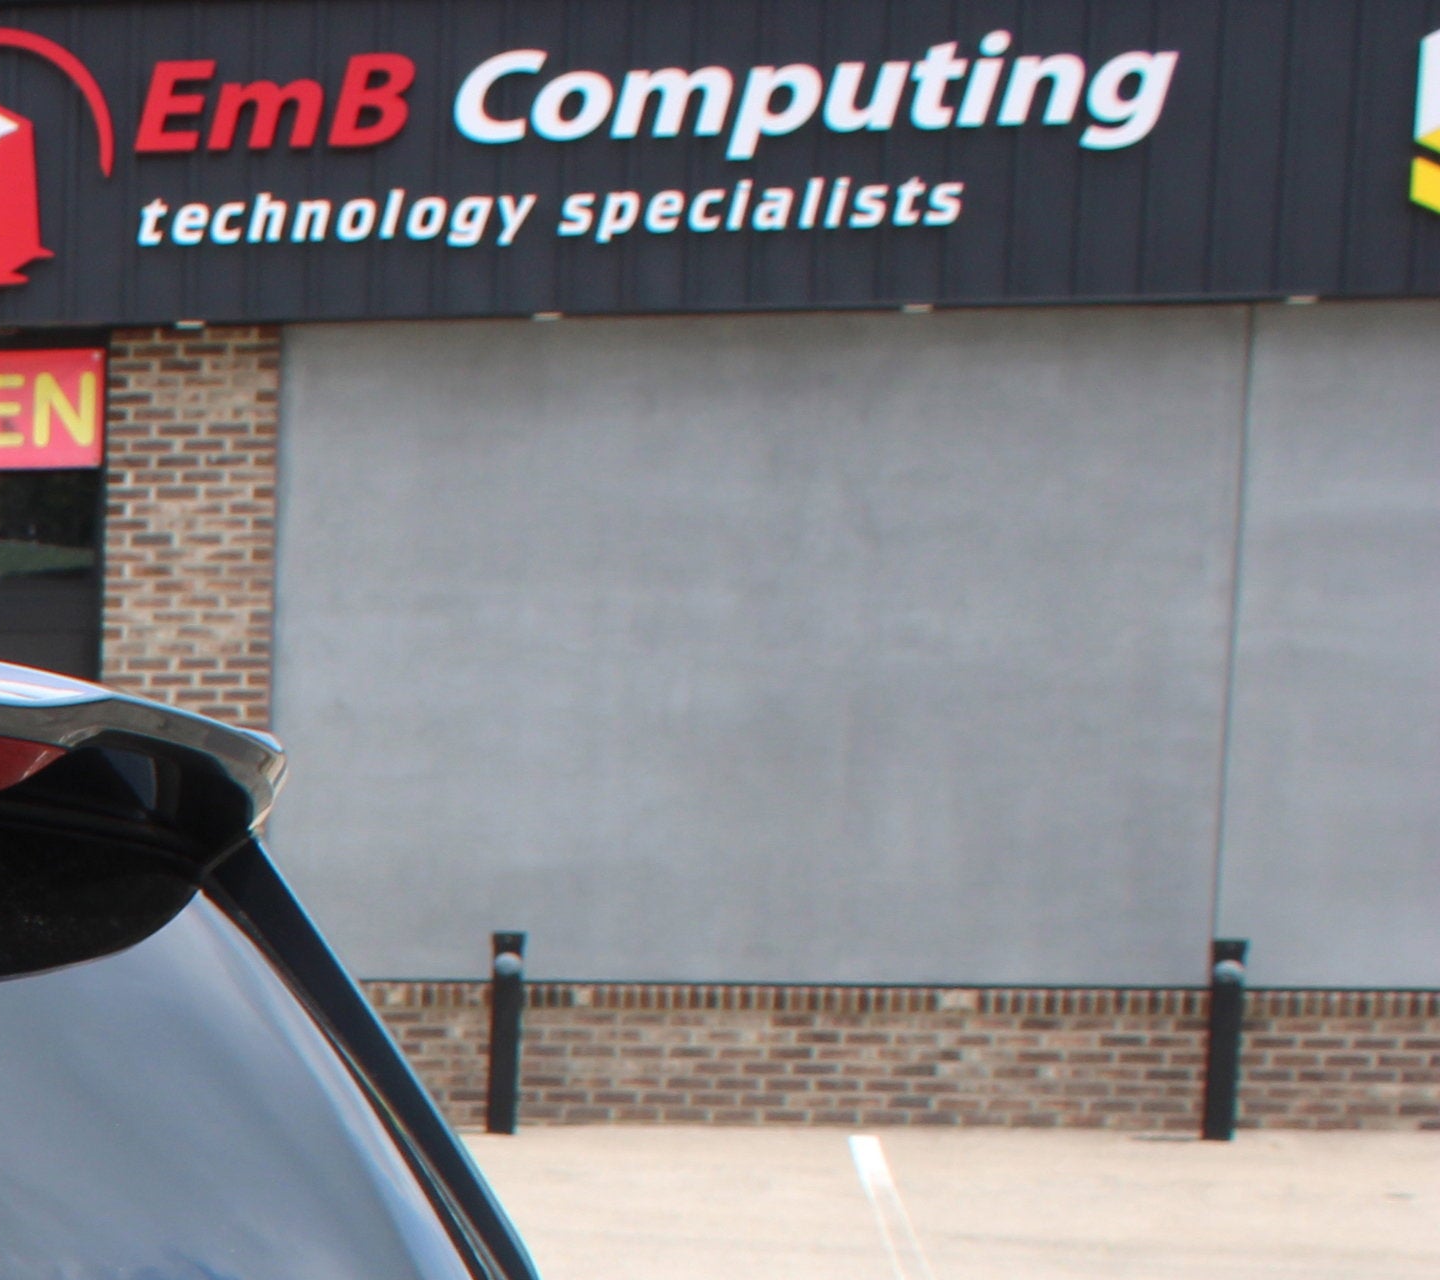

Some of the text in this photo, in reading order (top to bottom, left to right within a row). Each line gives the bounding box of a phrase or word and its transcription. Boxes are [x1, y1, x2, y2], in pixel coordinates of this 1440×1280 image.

[134, 29, 1179, 161] EmB Computing
[137, 176, 964, 247] technology specialists
